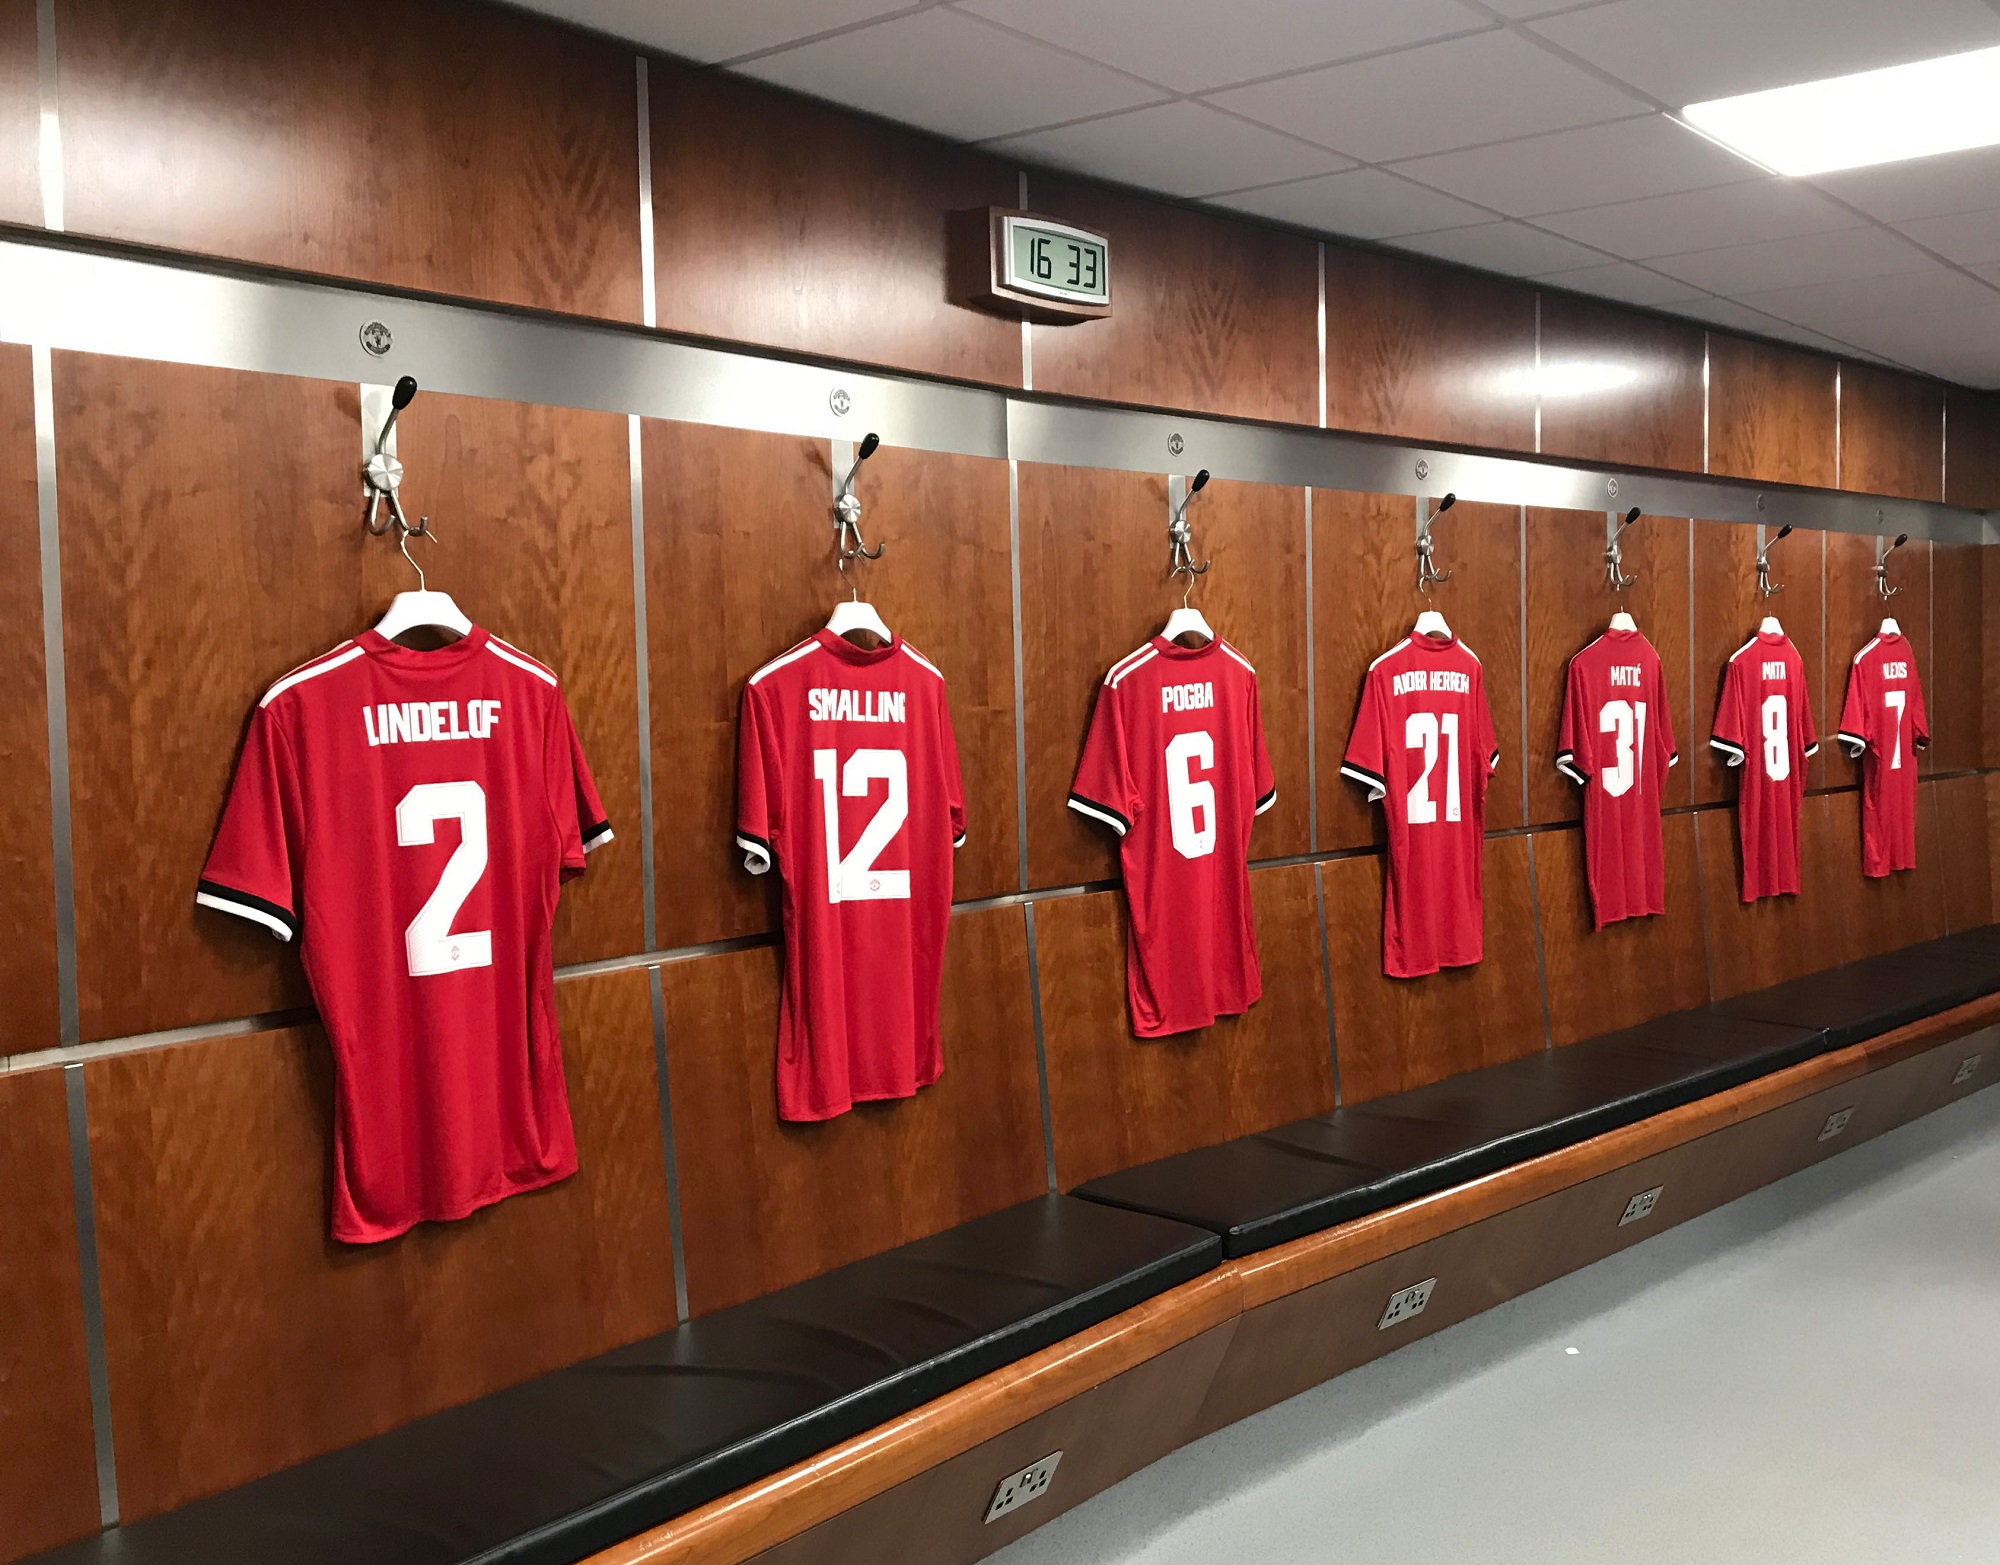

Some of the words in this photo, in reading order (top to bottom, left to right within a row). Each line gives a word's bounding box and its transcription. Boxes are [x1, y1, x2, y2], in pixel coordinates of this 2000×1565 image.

[1030, 237, 1051, 279] 16
[1067, 244, 1097, 289] 33
[1162, 682, 1214, 713] POGBA
[1611, 663, 1641, 687] MATIĆ
[1762, 661, 1786, 680] MATA
[363, 699, 501, 747] LINDELOF
[1600, 700, 1647, 797] 31
[1761, 694, 1790, 781] 8
[1885, 690, 1906, 769] 7
[1165, 730, 1216, 859] 6
[1406, 712, 1461, 824] 21
[813, 748, 911, 904] 12
[395, 780, 492, 976] 2
